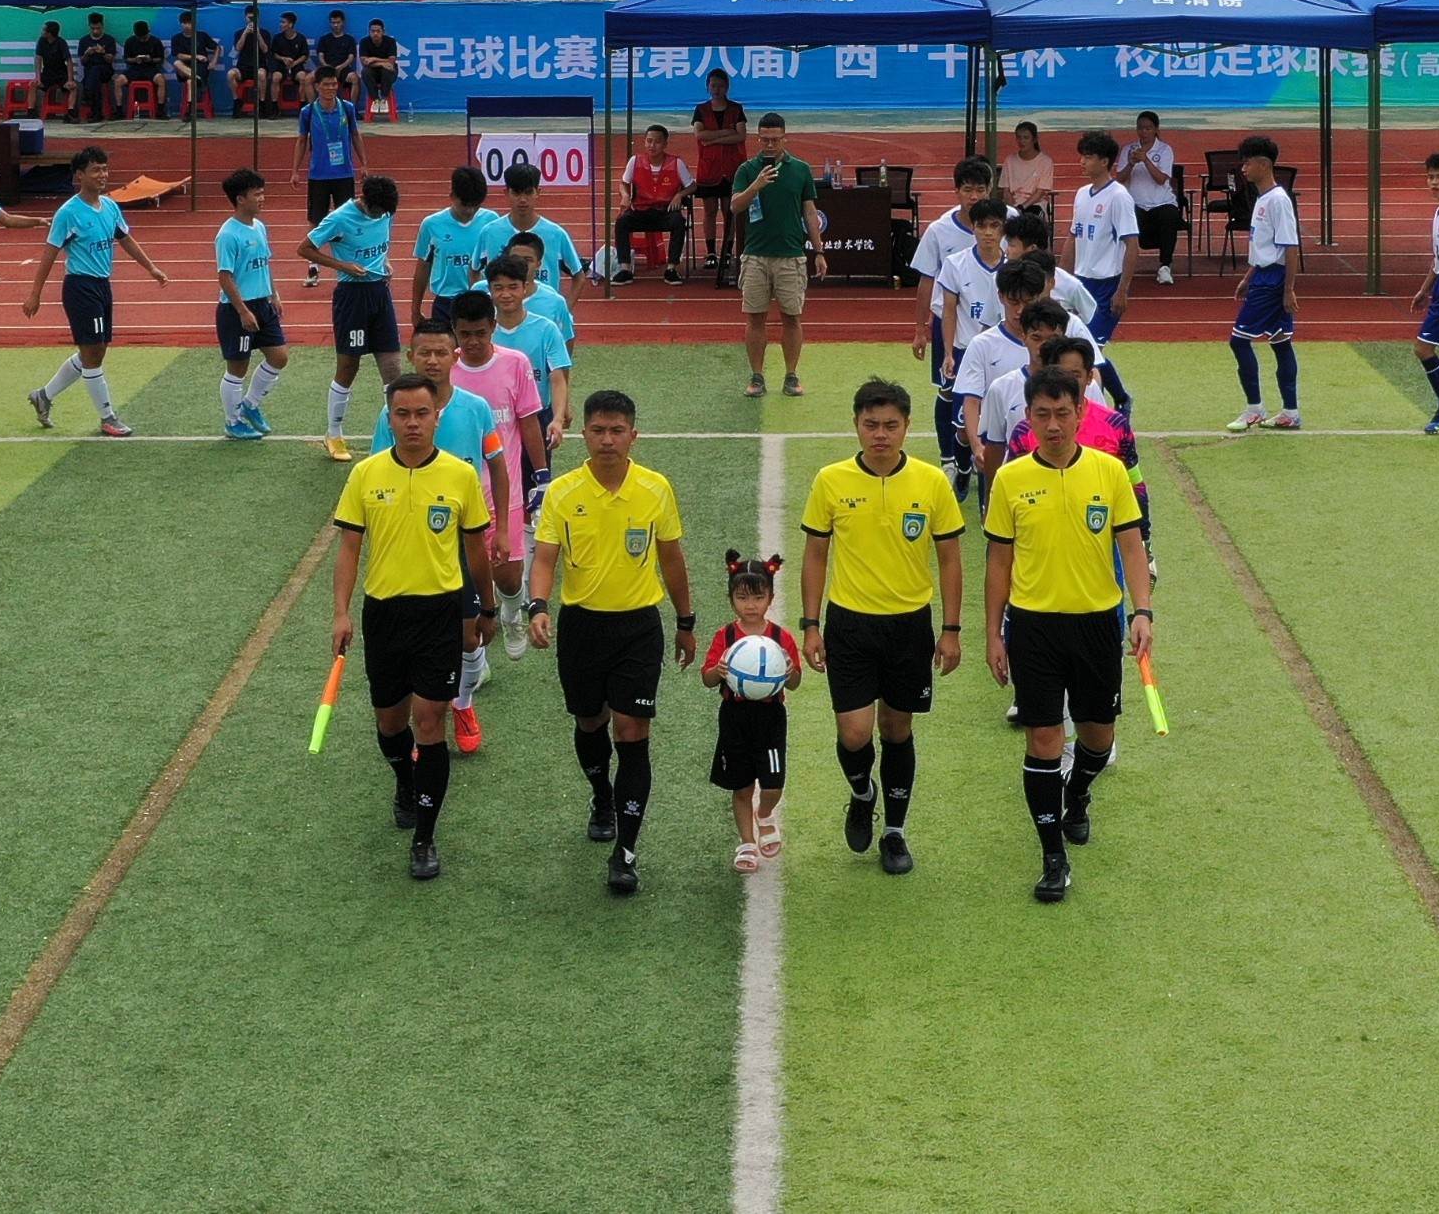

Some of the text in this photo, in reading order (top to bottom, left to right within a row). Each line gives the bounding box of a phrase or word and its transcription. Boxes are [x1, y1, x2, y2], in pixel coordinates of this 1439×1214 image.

[93, 317, 104, 334] 11
[238, 335, 251, 353] 10
[349, 329, 365, 348] 98
[1019, 489, 1047, 499] KELME
[767, 748, 781, 773] 11
